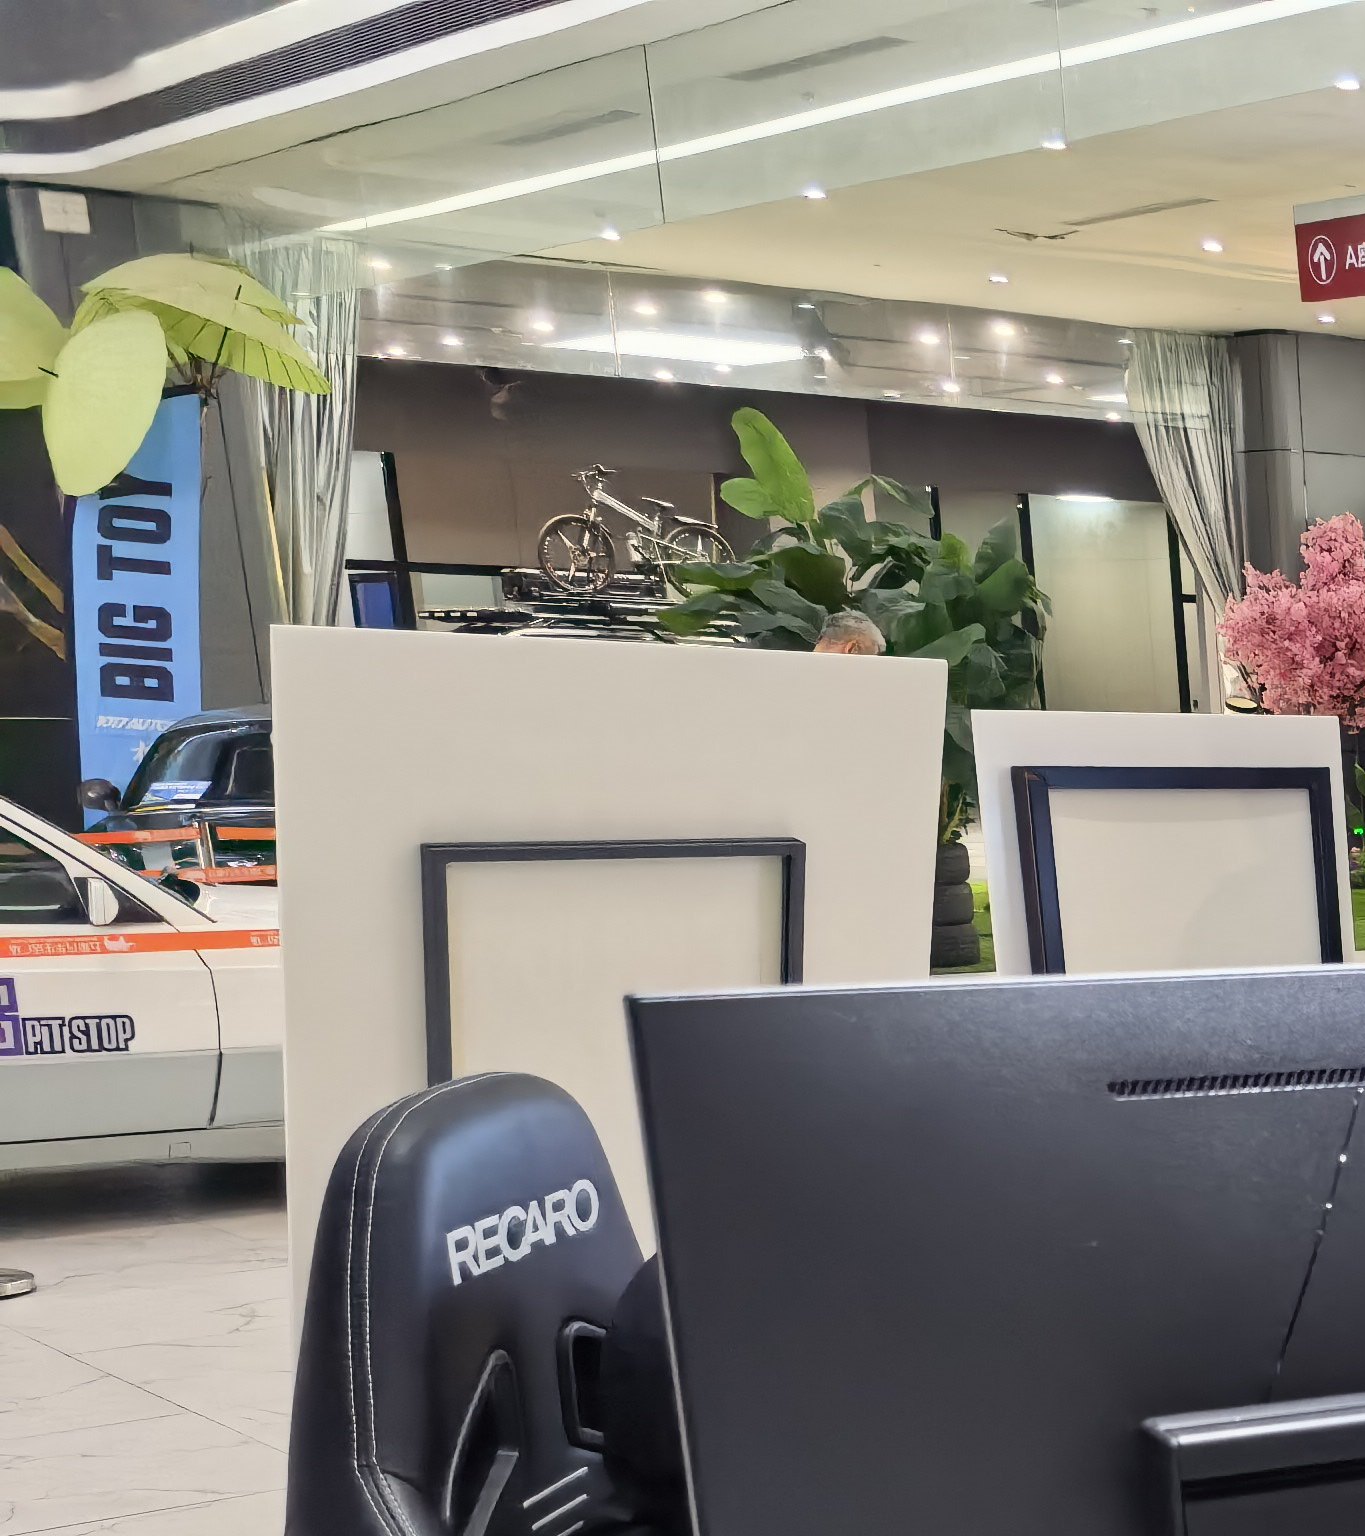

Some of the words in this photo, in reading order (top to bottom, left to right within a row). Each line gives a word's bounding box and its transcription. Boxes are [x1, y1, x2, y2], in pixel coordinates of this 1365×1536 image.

[97, 602, 174, 703] BIG
[71, 1017, 132, 1051] STOP
[446, 1179, 599, 1287] RECARO
